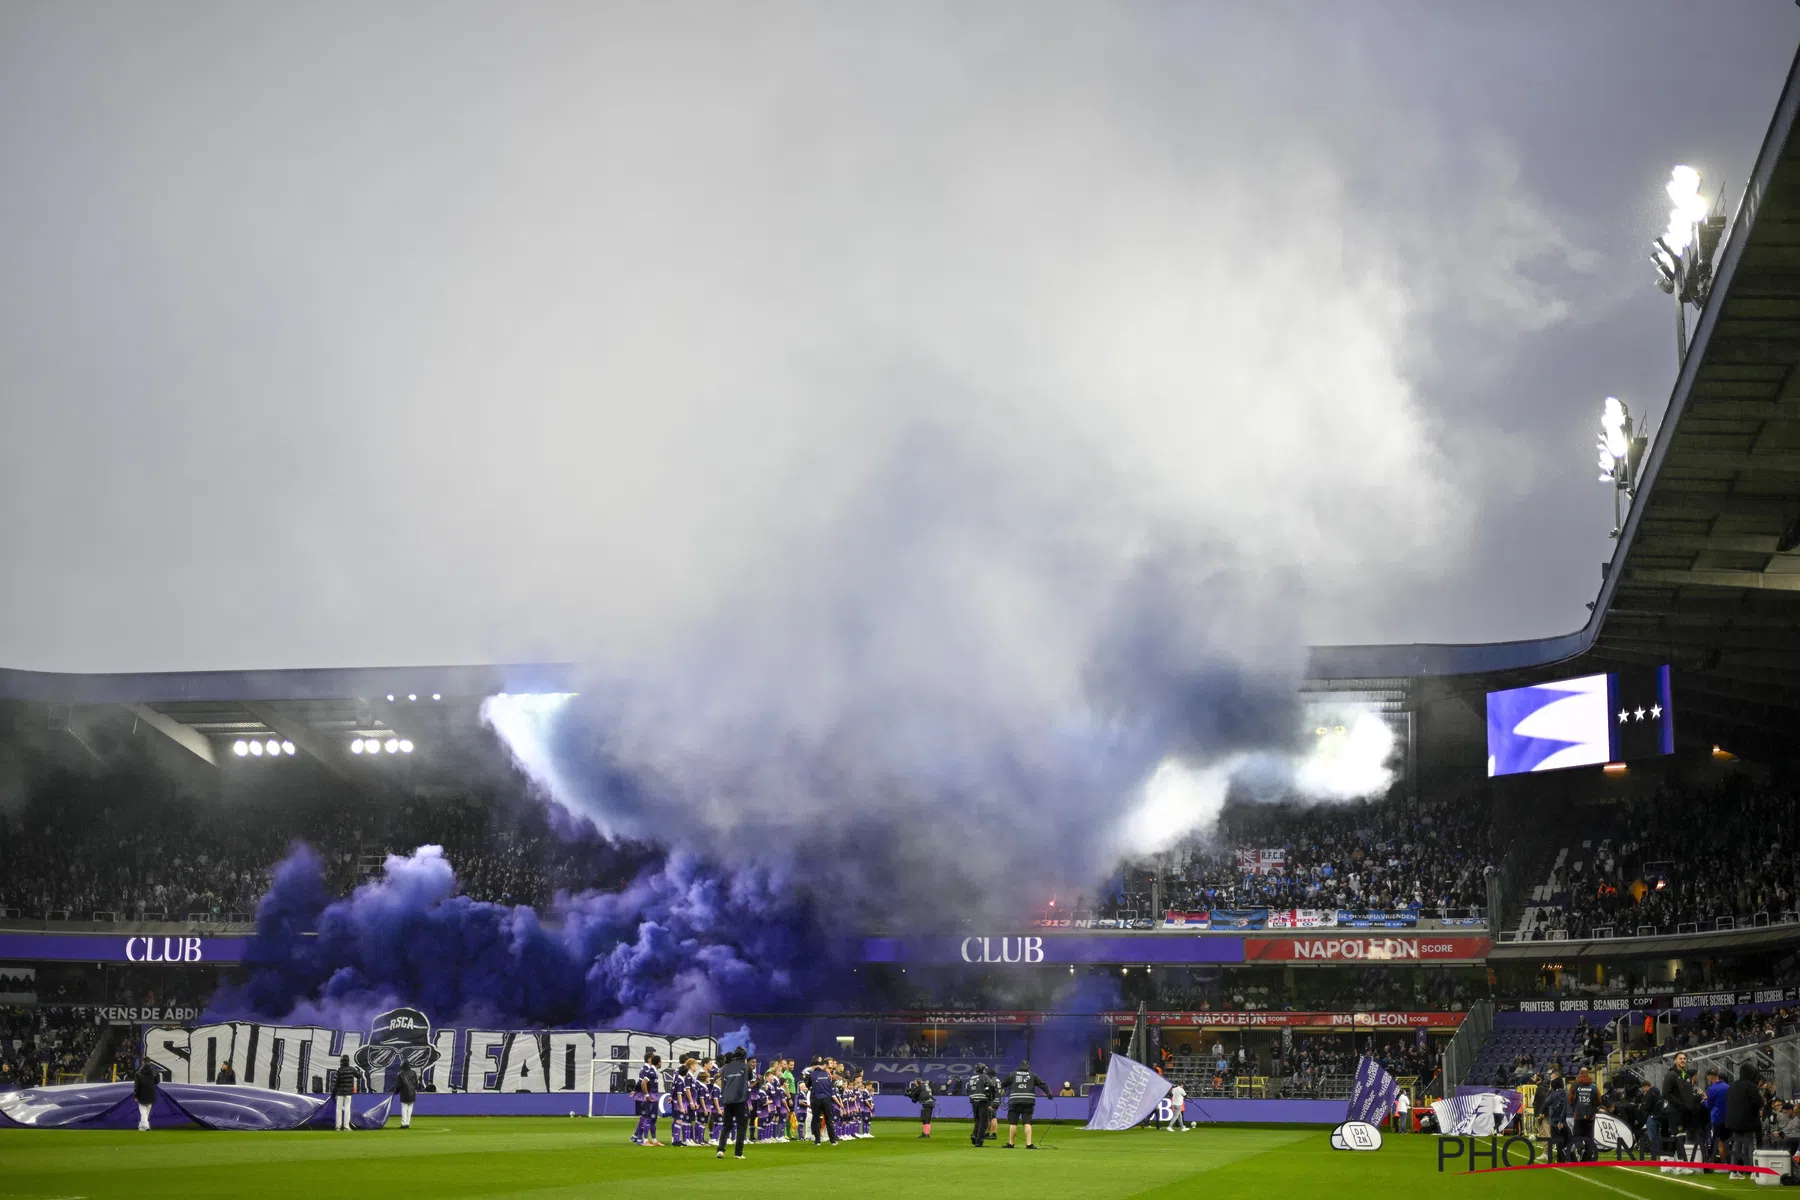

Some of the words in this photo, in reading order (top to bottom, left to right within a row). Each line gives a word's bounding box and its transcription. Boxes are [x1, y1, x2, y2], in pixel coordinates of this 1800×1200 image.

[126, 937, 202, 962] CLUB
[961, 937, 1044, 963] CLUB
[1294, 941, 1418, 958] NAPOLEON
[1421, 944, 1453, 953] SCORE
[1633, 997, 1654, 1006] COPY
[1673, 995, 1709, 1008] INTERACTIVE
[1709, 993, 1735, 1006] SCREENS
[1764, 989, 1784, 1003] SCREENS
[1520, 1000, 1555, 1012] PRINTERS
[1560, 999, 1589, 1012] COPIERS
[1593, 998, 1629, 1011] SCANNERS
[141, 1007, 160, 1020] DE
[1192, 1013, 1267, 1025] NAPOLEON
[1333, 1013, 1408, 1025] NAPOLEON
[389, 1017, 414, 1031] RSCA
[145, 1021, 364, 1094] SOUTH
[1354, 1127, 1366, 1136] DA
[1357, 1135, 1368, 1144] ZN
